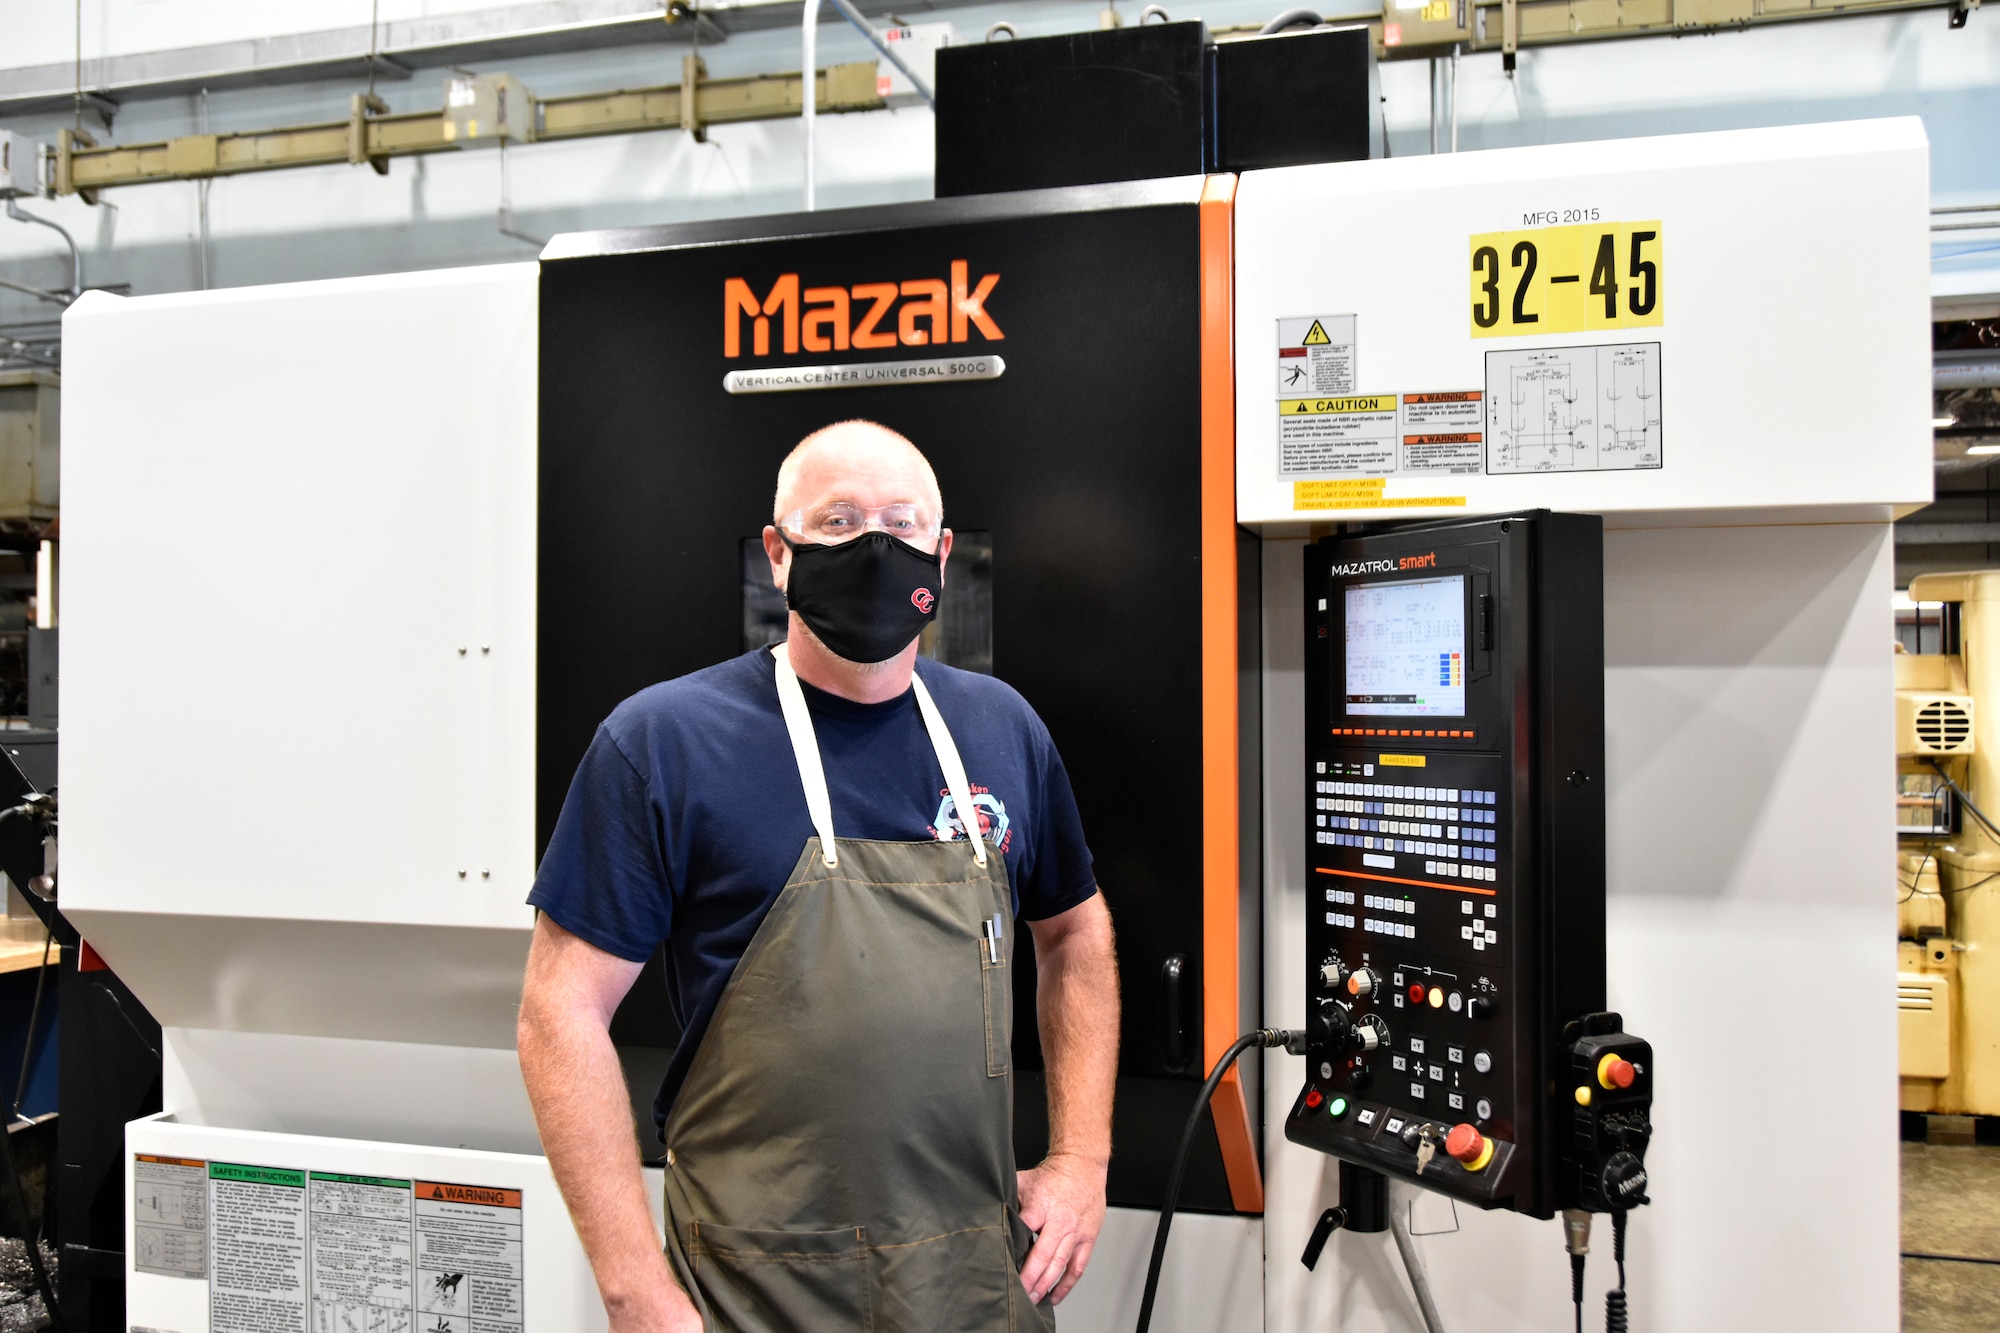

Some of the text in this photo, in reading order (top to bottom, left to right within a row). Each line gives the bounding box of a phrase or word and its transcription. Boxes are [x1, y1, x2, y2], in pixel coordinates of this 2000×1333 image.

[1523, 208, 1600, 226] MFG 2015
[1473, 231, 1657, 328] 32-45
[724, 258, 1005, 358] Mazak
[736, 362, 986, 386] VERTICAL CENTER UNIVERSAL 500C
[1316, 399, 1378, 411] CAUTION
[1427, 393, 1468, 402] WARNING
[1428, 434, 1468, 443] WARNING
[1332, 551, 1436, 576] MAZATROL smart
[214, 1167, 242, 1177] SAFETY
[245, 1170, 301, 1183] INSTRUCTIONS
[446, 1187, 504, 1204] WARNING
